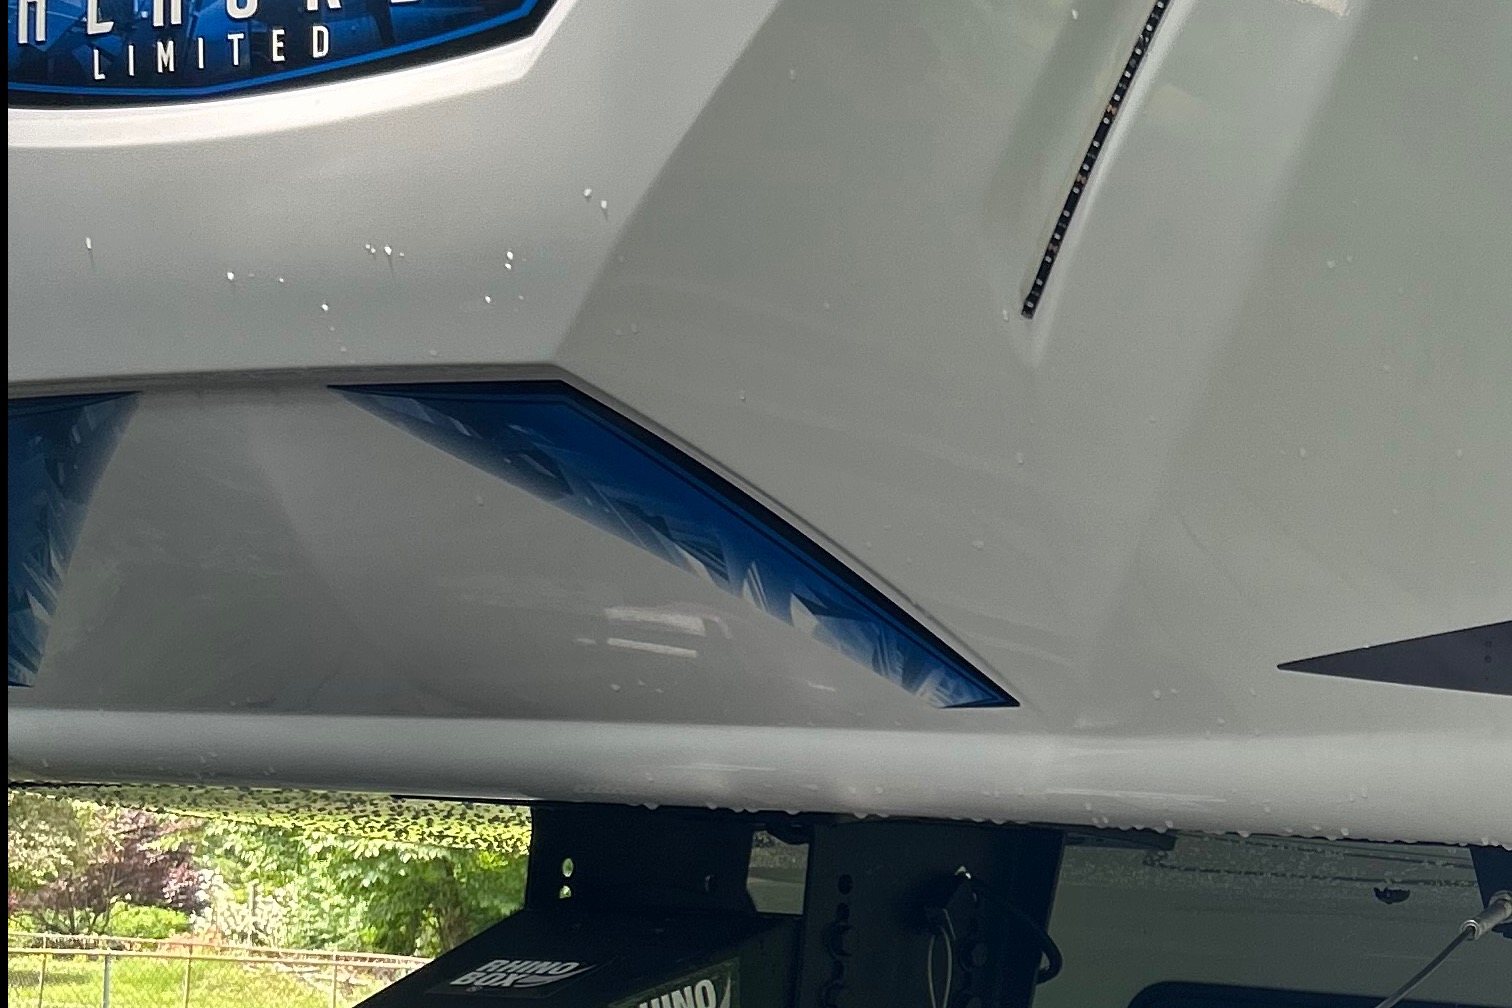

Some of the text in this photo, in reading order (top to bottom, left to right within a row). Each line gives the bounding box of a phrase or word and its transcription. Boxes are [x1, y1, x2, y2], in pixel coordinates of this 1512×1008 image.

[92, 25, 329, 80] LIMITED
[476, 959, 580, 975] RHINO
[450, 971, 531, 988] BOX
